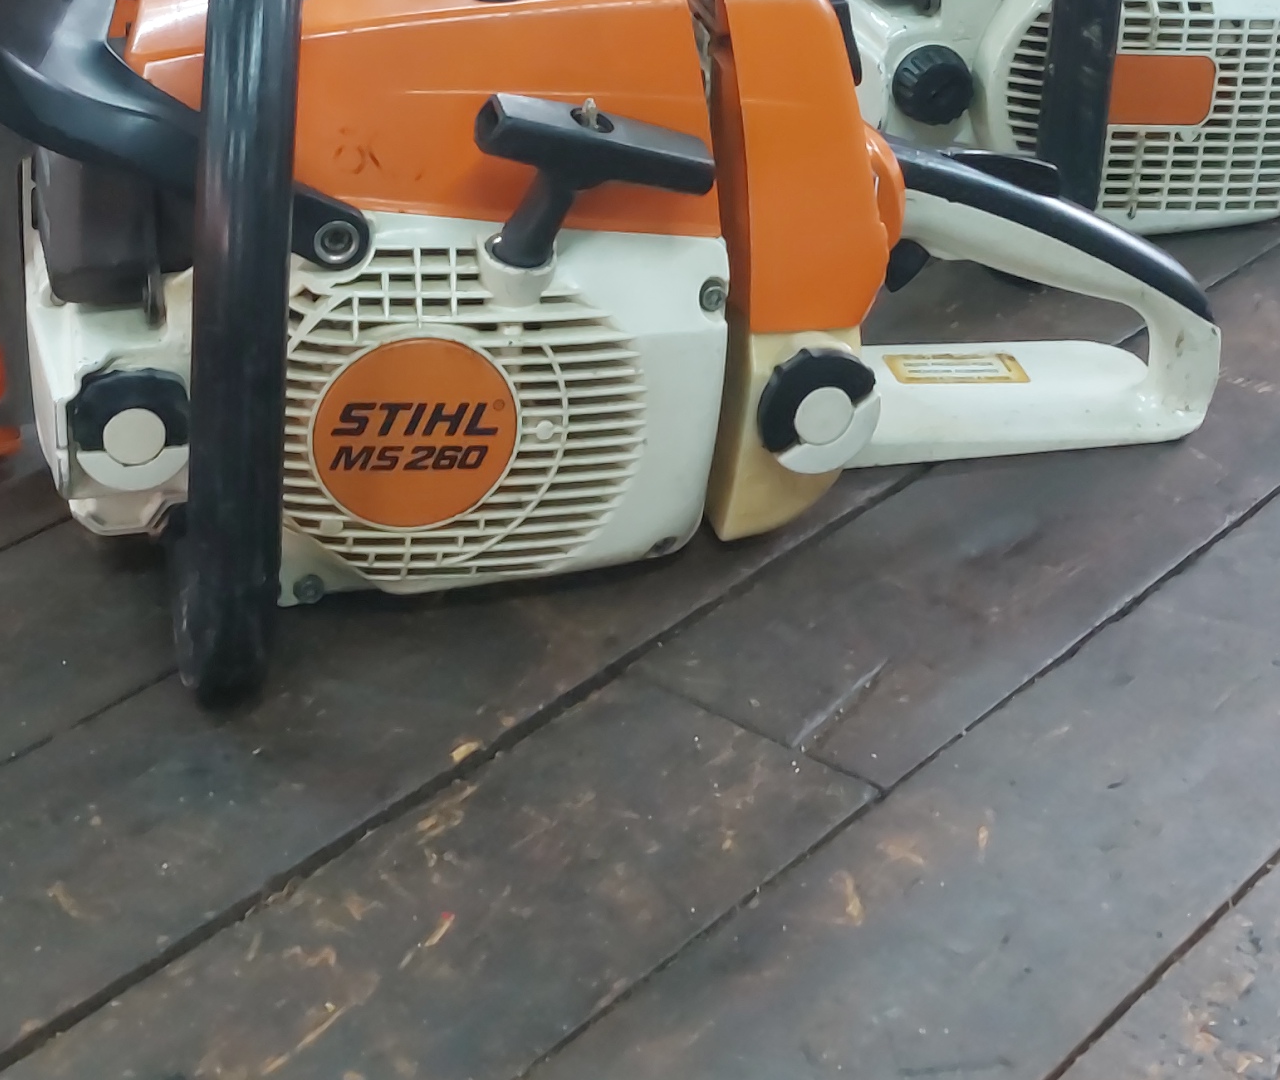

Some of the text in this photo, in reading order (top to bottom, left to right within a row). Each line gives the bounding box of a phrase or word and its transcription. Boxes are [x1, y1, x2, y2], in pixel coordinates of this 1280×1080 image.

[331, 402, 499, 437] STIHL
[329, 445, 489, 471] MS 260
